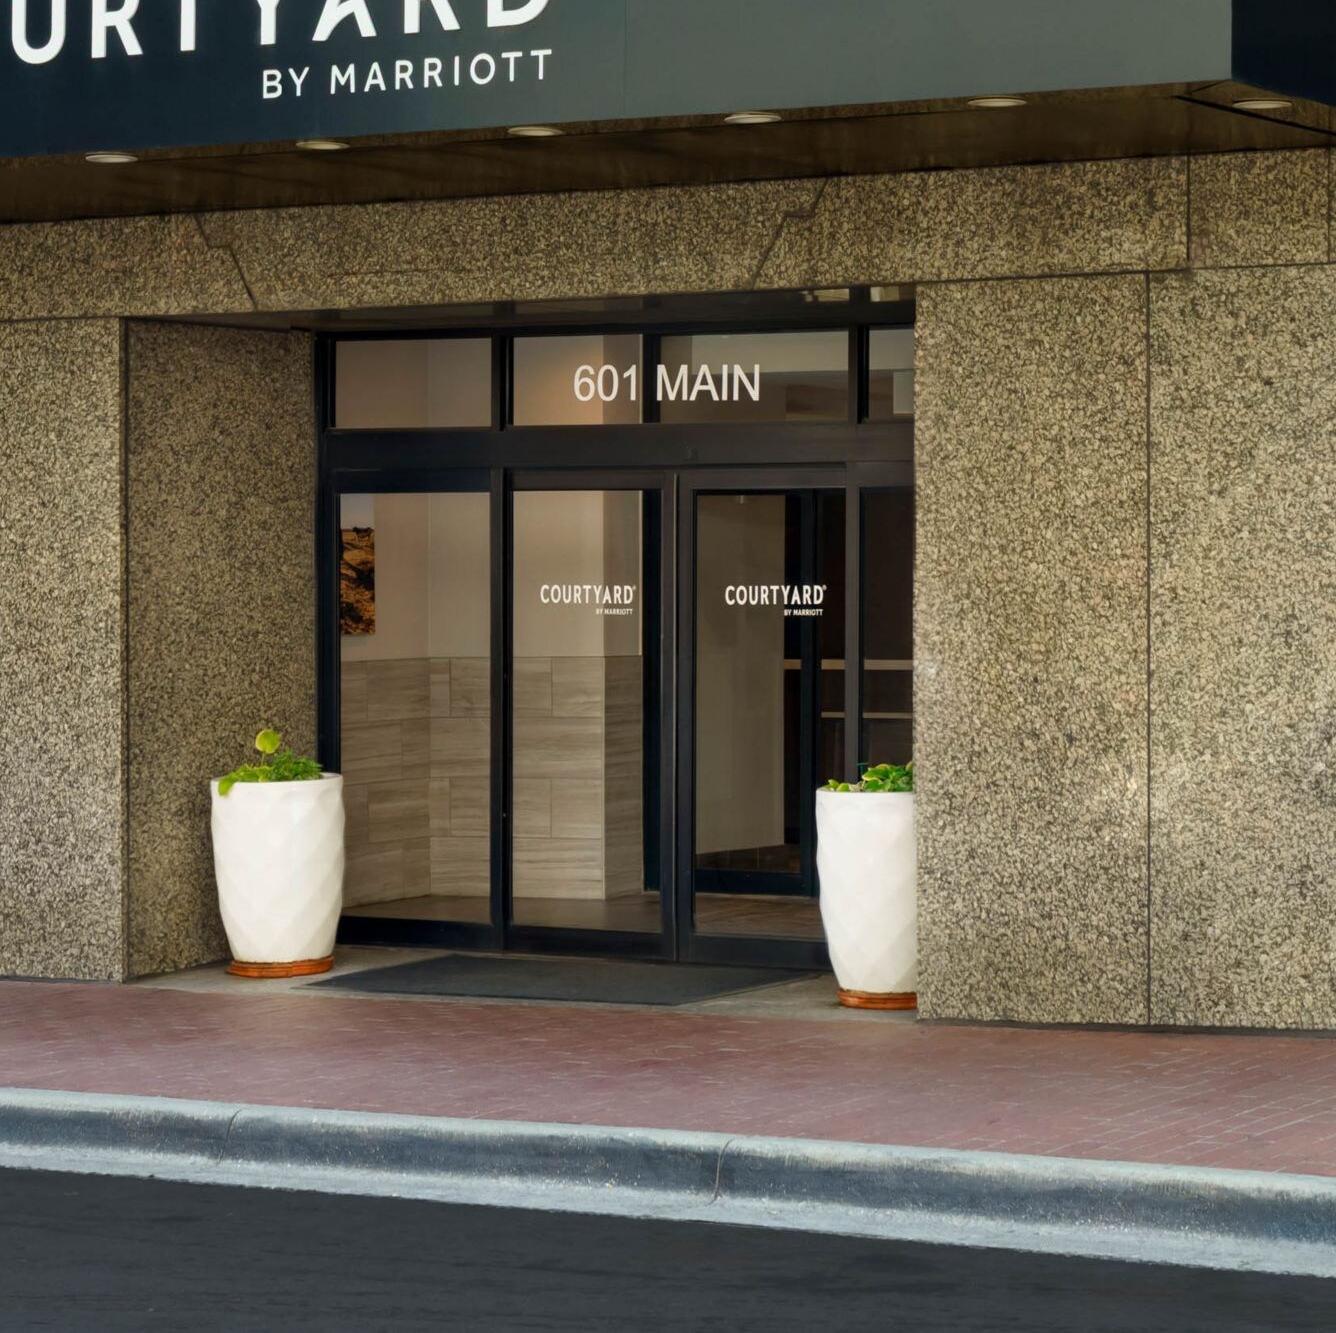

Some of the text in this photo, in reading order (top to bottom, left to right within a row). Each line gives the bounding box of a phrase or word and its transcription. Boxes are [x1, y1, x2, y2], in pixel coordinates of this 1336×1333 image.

[262, 48, 553, 99] BY MARRIOTT
[573, 363, 761, 402] 601 MAIN
[783, 608, 824, 616] BY MARRIOTT
